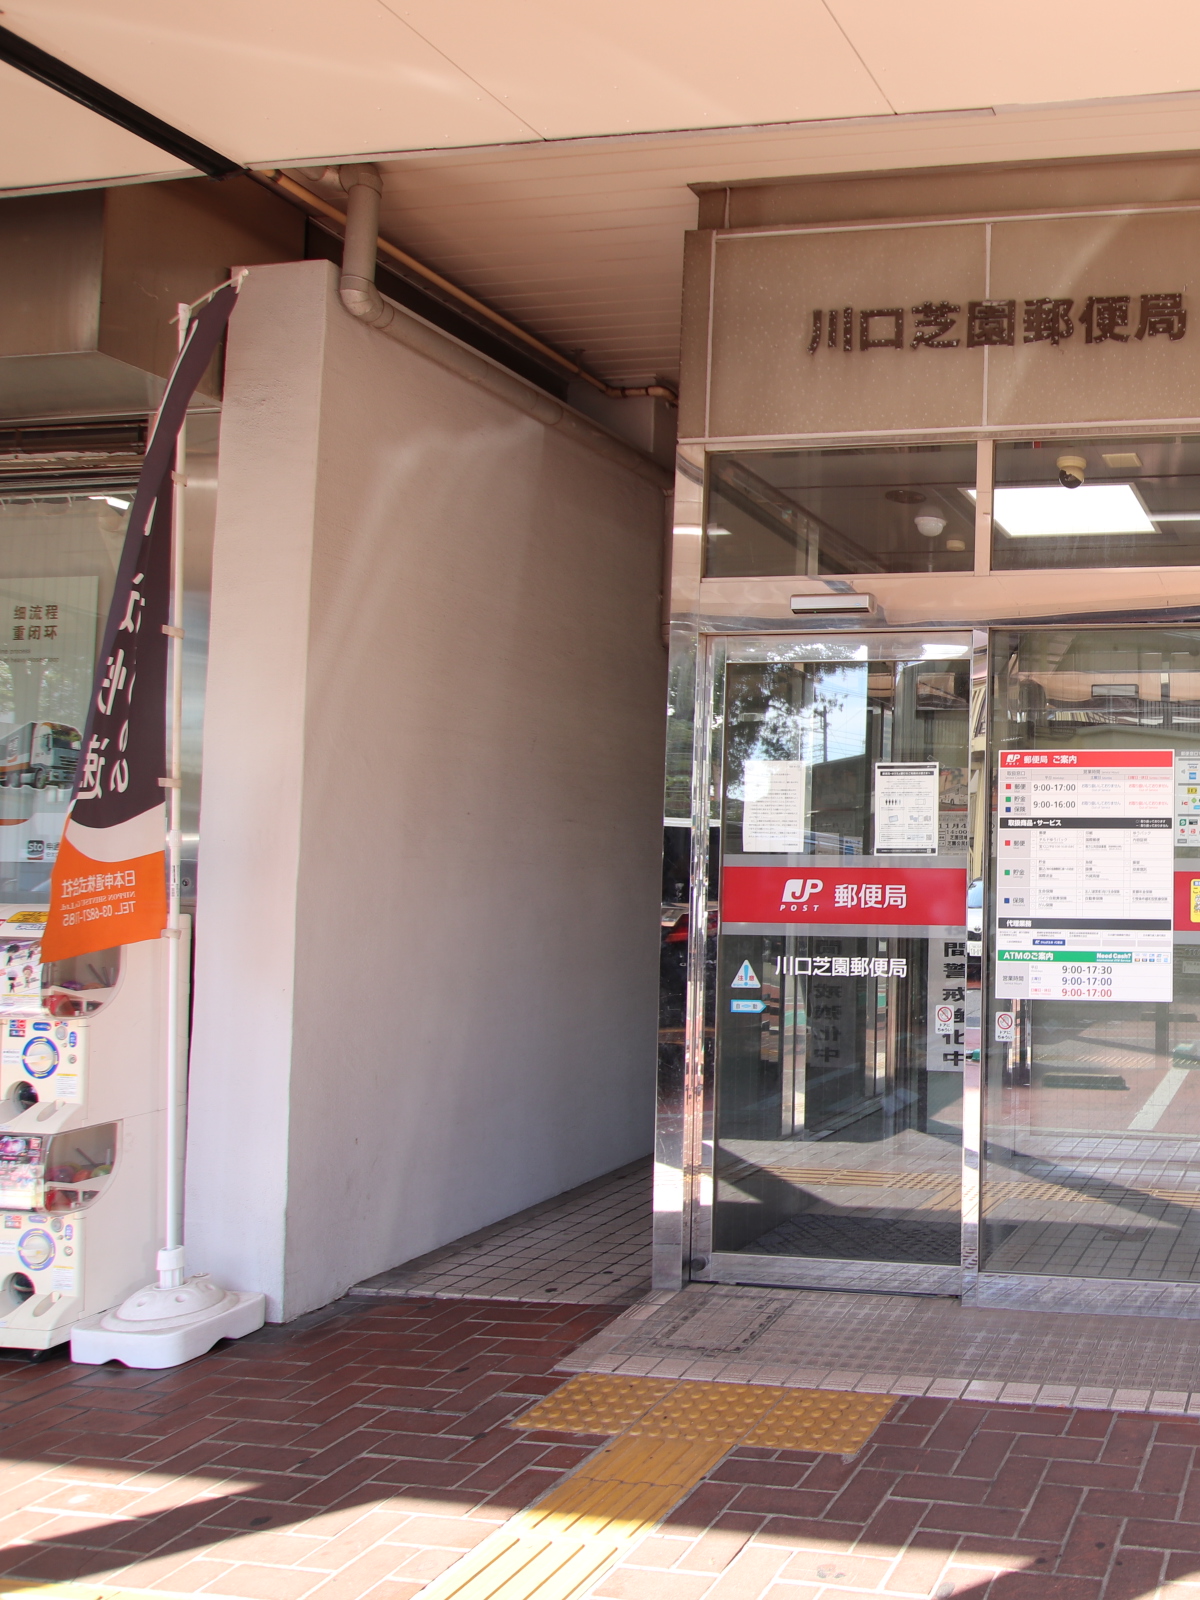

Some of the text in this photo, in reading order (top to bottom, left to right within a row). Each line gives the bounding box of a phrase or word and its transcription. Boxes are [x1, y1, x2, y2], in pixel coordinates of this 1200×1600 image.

[807, 293, 1187, 355] 川口芝園郵便局
[1023, 755, 1048, 764] 郵便局
[1053, 755, 1077, 764] ご案内
[1033, 783, 1076, 791] 9:00-17:00
[1008, 819, 1062, 827] 取扱商品・サービス
[28, 841, 44, 851] sto
[782, 879, 823, 902] JP
[834, 883, 907, 909] 郵便局
[779, 904, 820, 912] POST
[1003, 952, 1054, 960] ATMのご案内
[775, 956, 907, 978] 川口芝園郵便局
[1062, 966, 1112, 975] 9:00-17:30
[1062, 977, 1112, 986] 9:00-17:00
[1062, 988, 1112, 997] 9:00-17:00
